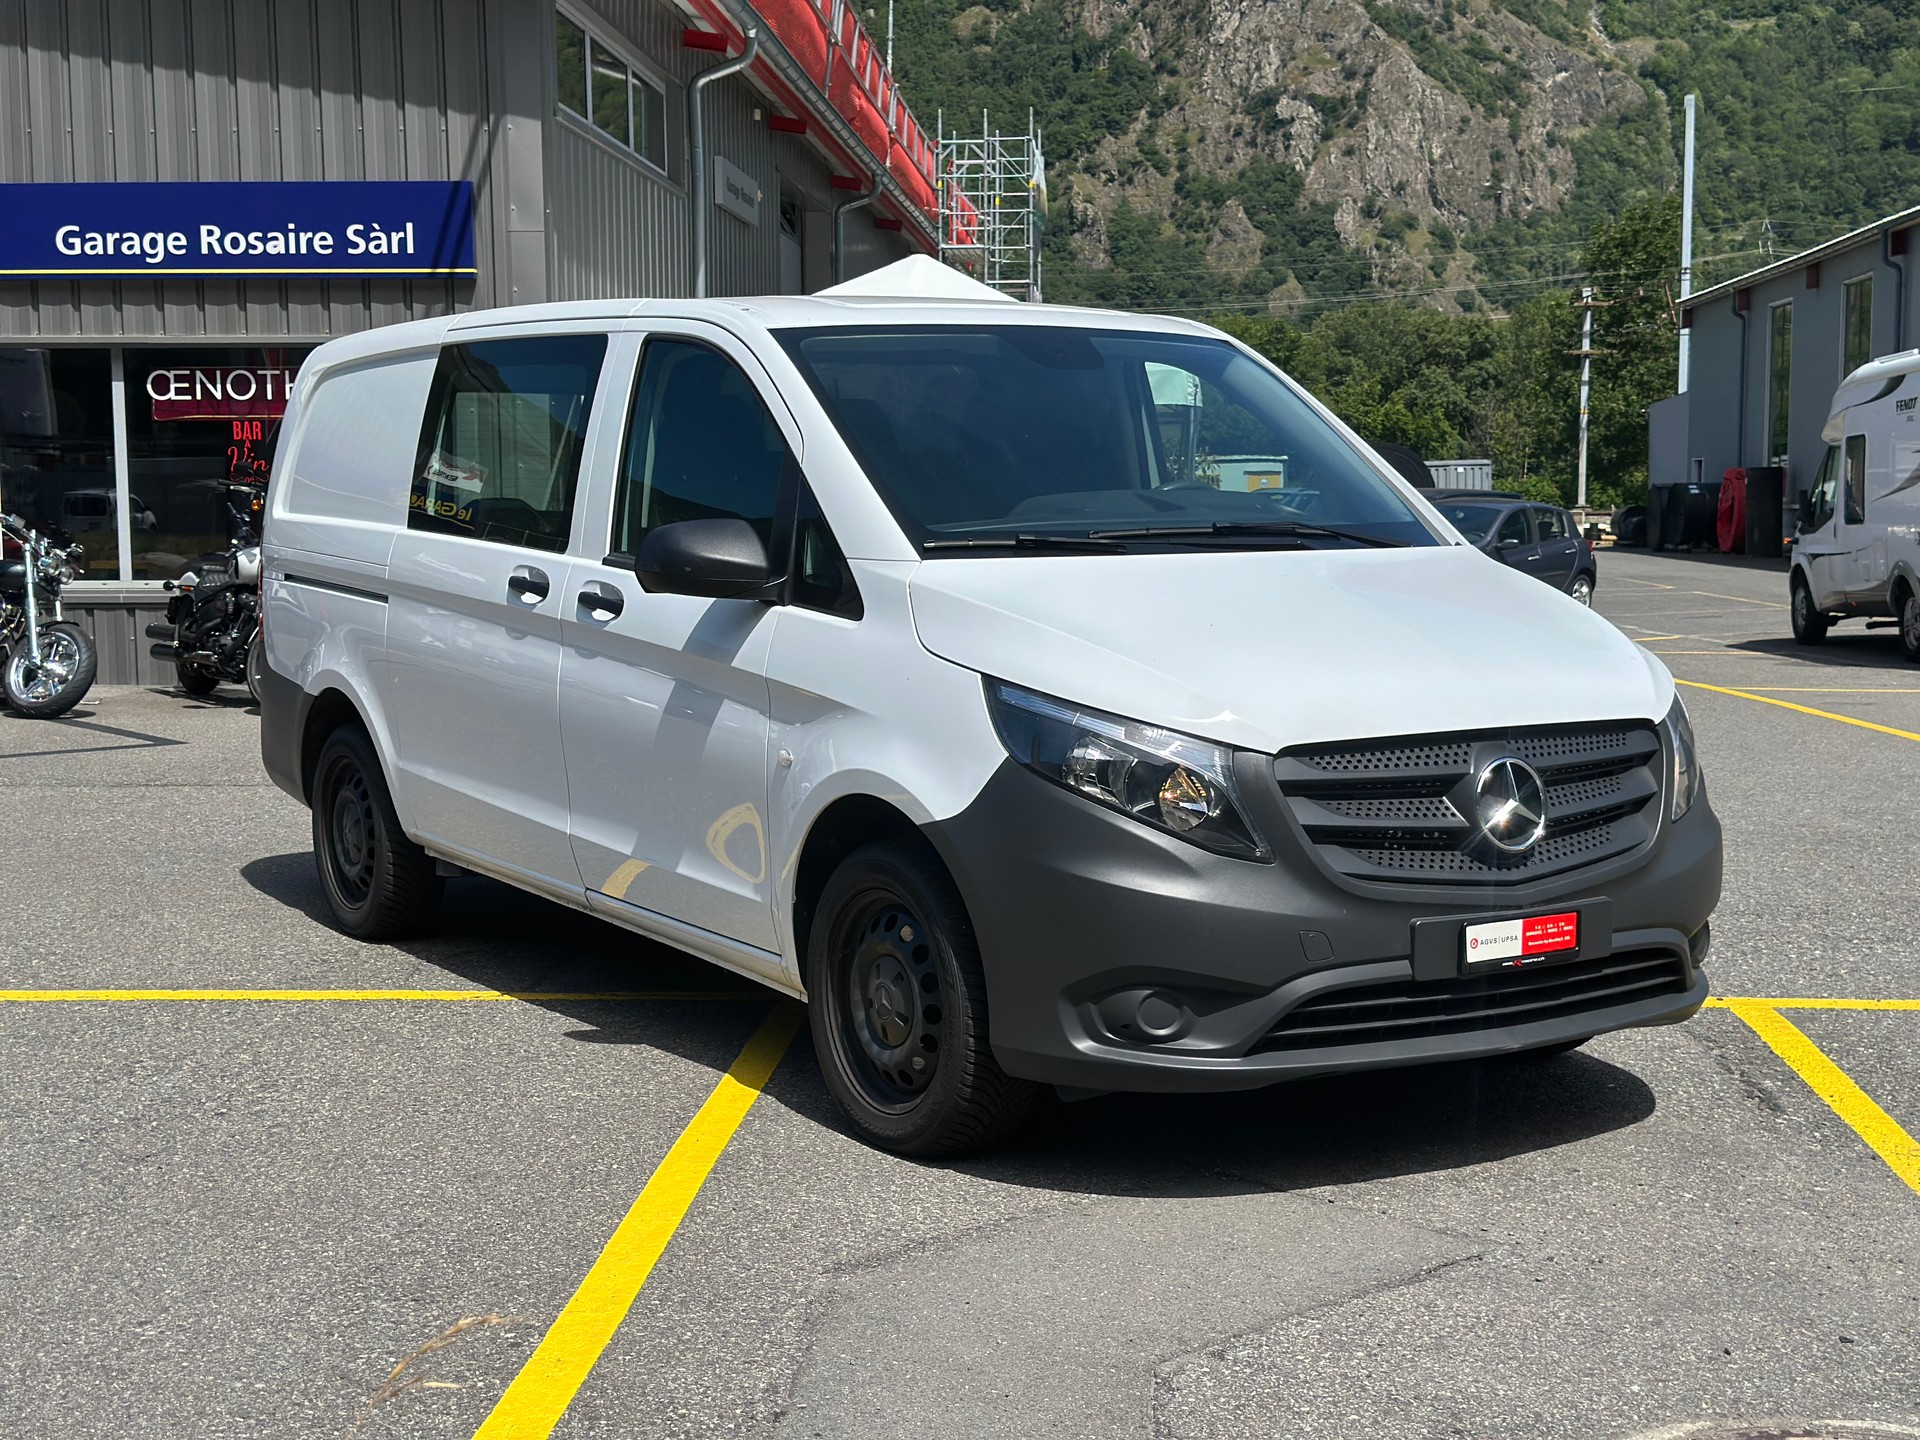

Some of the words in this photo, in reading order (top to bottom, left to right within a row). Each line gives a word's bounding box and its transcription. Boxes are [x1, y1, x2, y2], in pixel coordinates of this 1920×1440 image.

[55, 224, 188, 264] Garage
[200, 223, 334, 255] Rosaire
[346, 222, 415, 255] Sàrl
[232, 421, 263, 441] BAR
[1479, 937, 1498, 946] AGVS
[1501, 935, 1518, 943] UPSA
